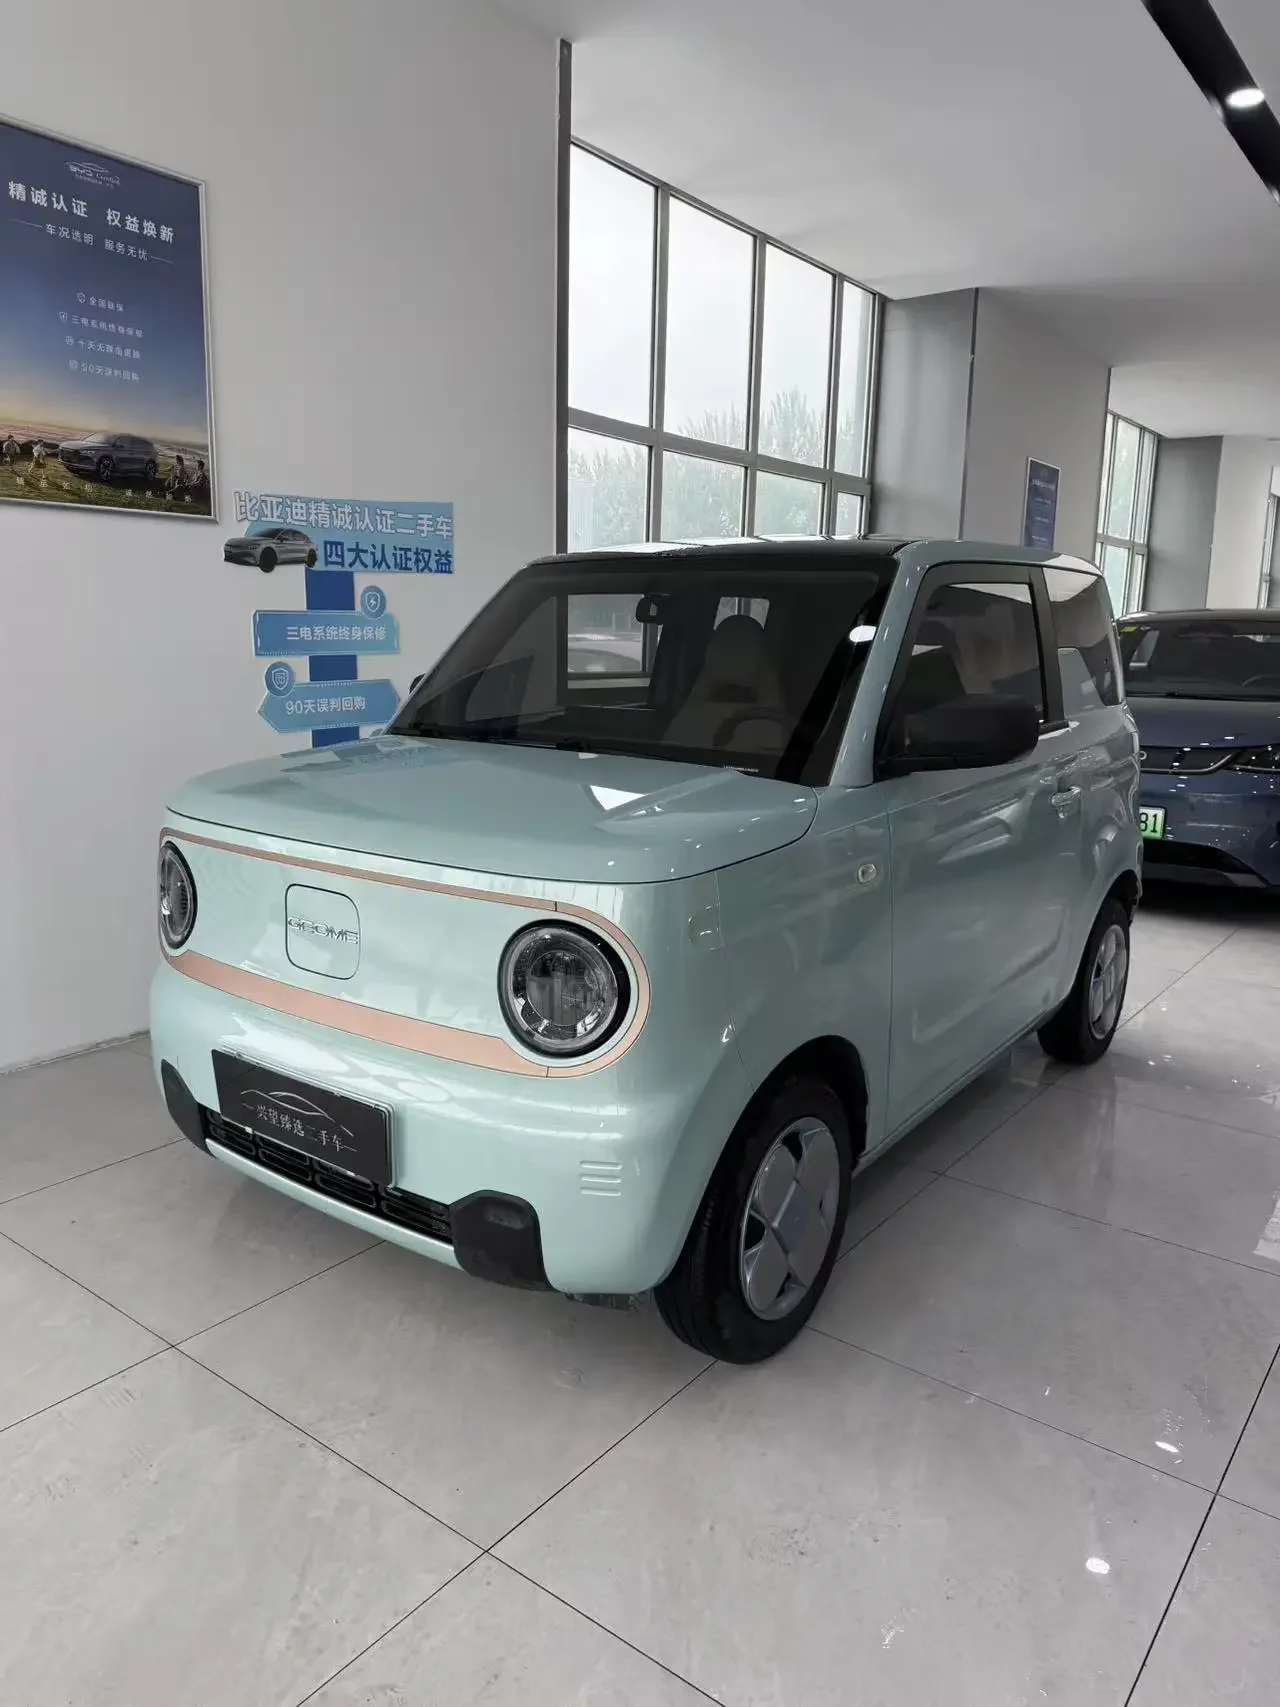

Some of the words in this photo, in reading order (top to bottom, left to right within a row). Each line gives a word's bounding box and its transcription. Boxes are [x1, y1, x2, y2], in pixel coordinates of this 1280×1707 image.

[8, 181, 89, 218] 精诚认证
[106, 208, 175, 243] 权益焕新
[45, 223, 94, 246] 车况透明
[104, 239, 148, 260] 服务无忧
[234, 490, 453, 540] 比亚迪精诚认证二手车
[323, 540, 453, 574] 四大认证权益
[286, 625, 387, 641] 三电系统终身保修
[285, 696, 366, 715] 90天误判回购
